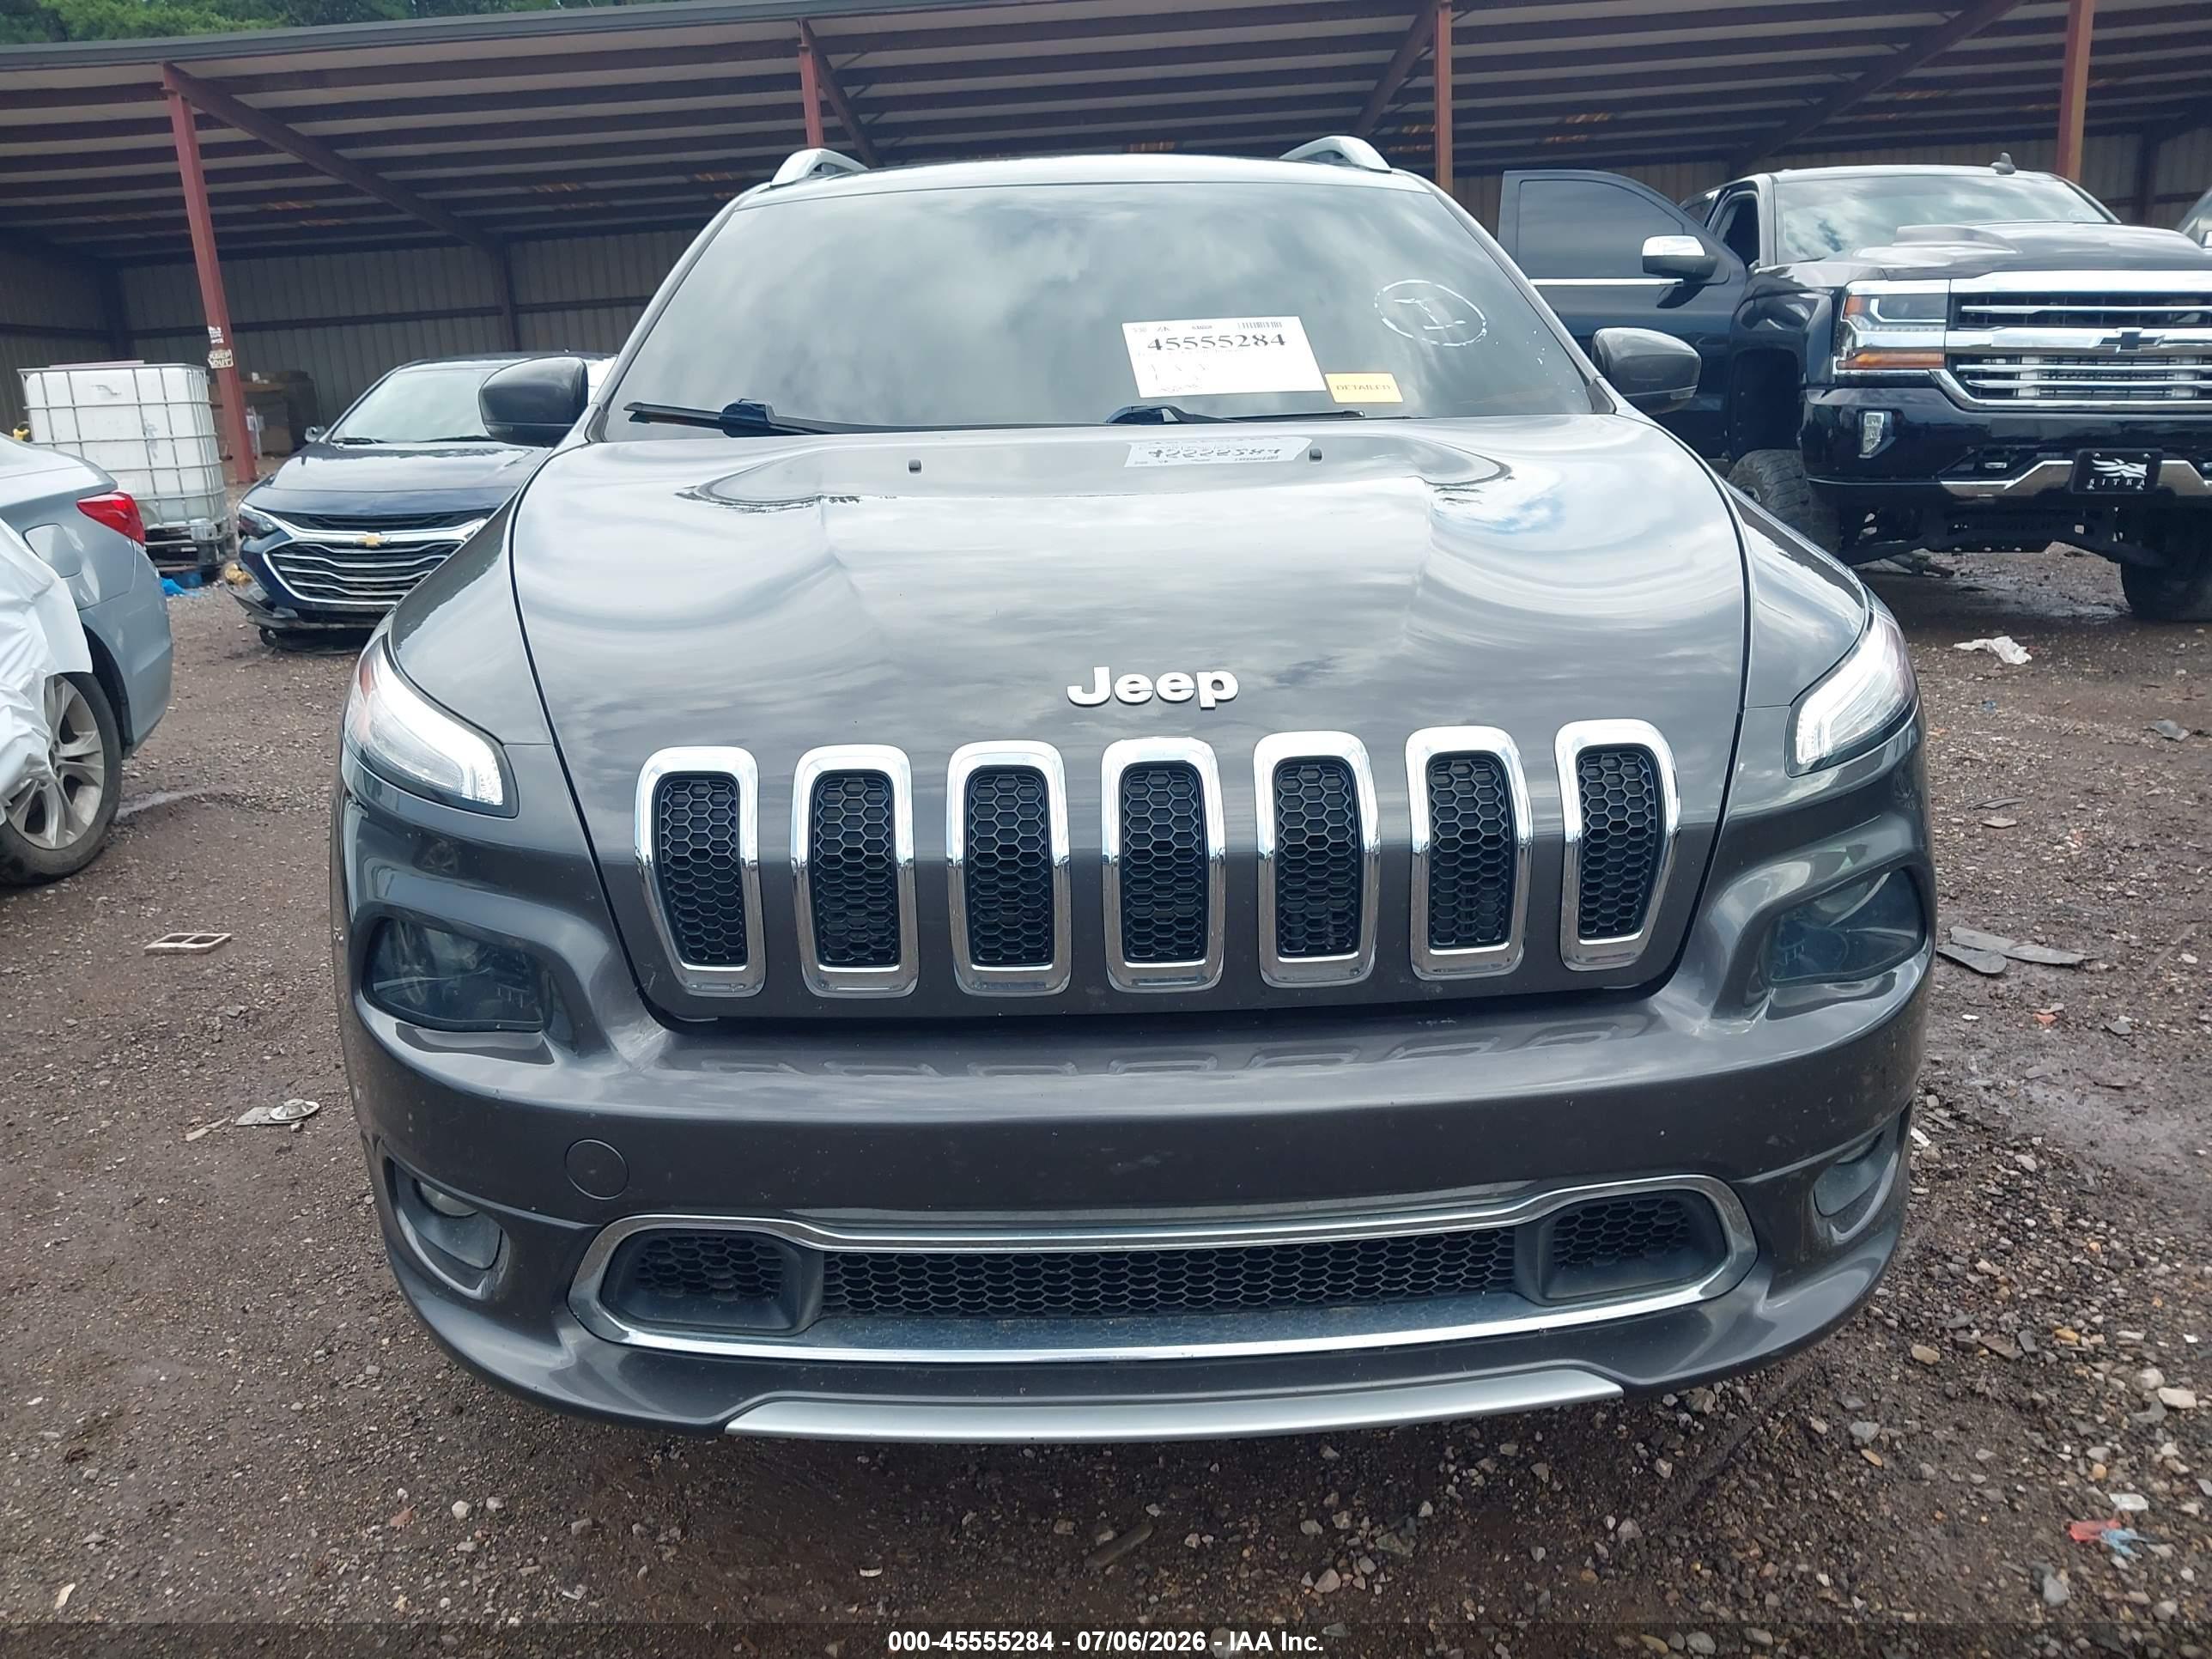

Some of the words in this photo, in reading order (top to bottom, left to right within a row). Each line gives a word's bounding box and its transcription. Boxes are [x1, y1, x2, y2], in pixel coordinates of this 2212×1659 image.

[1146, 333, 1286, 351] 45555284
[2088, 477, 2146, 486] SITKA
[1066, 666, 1239, 710] Jeep
